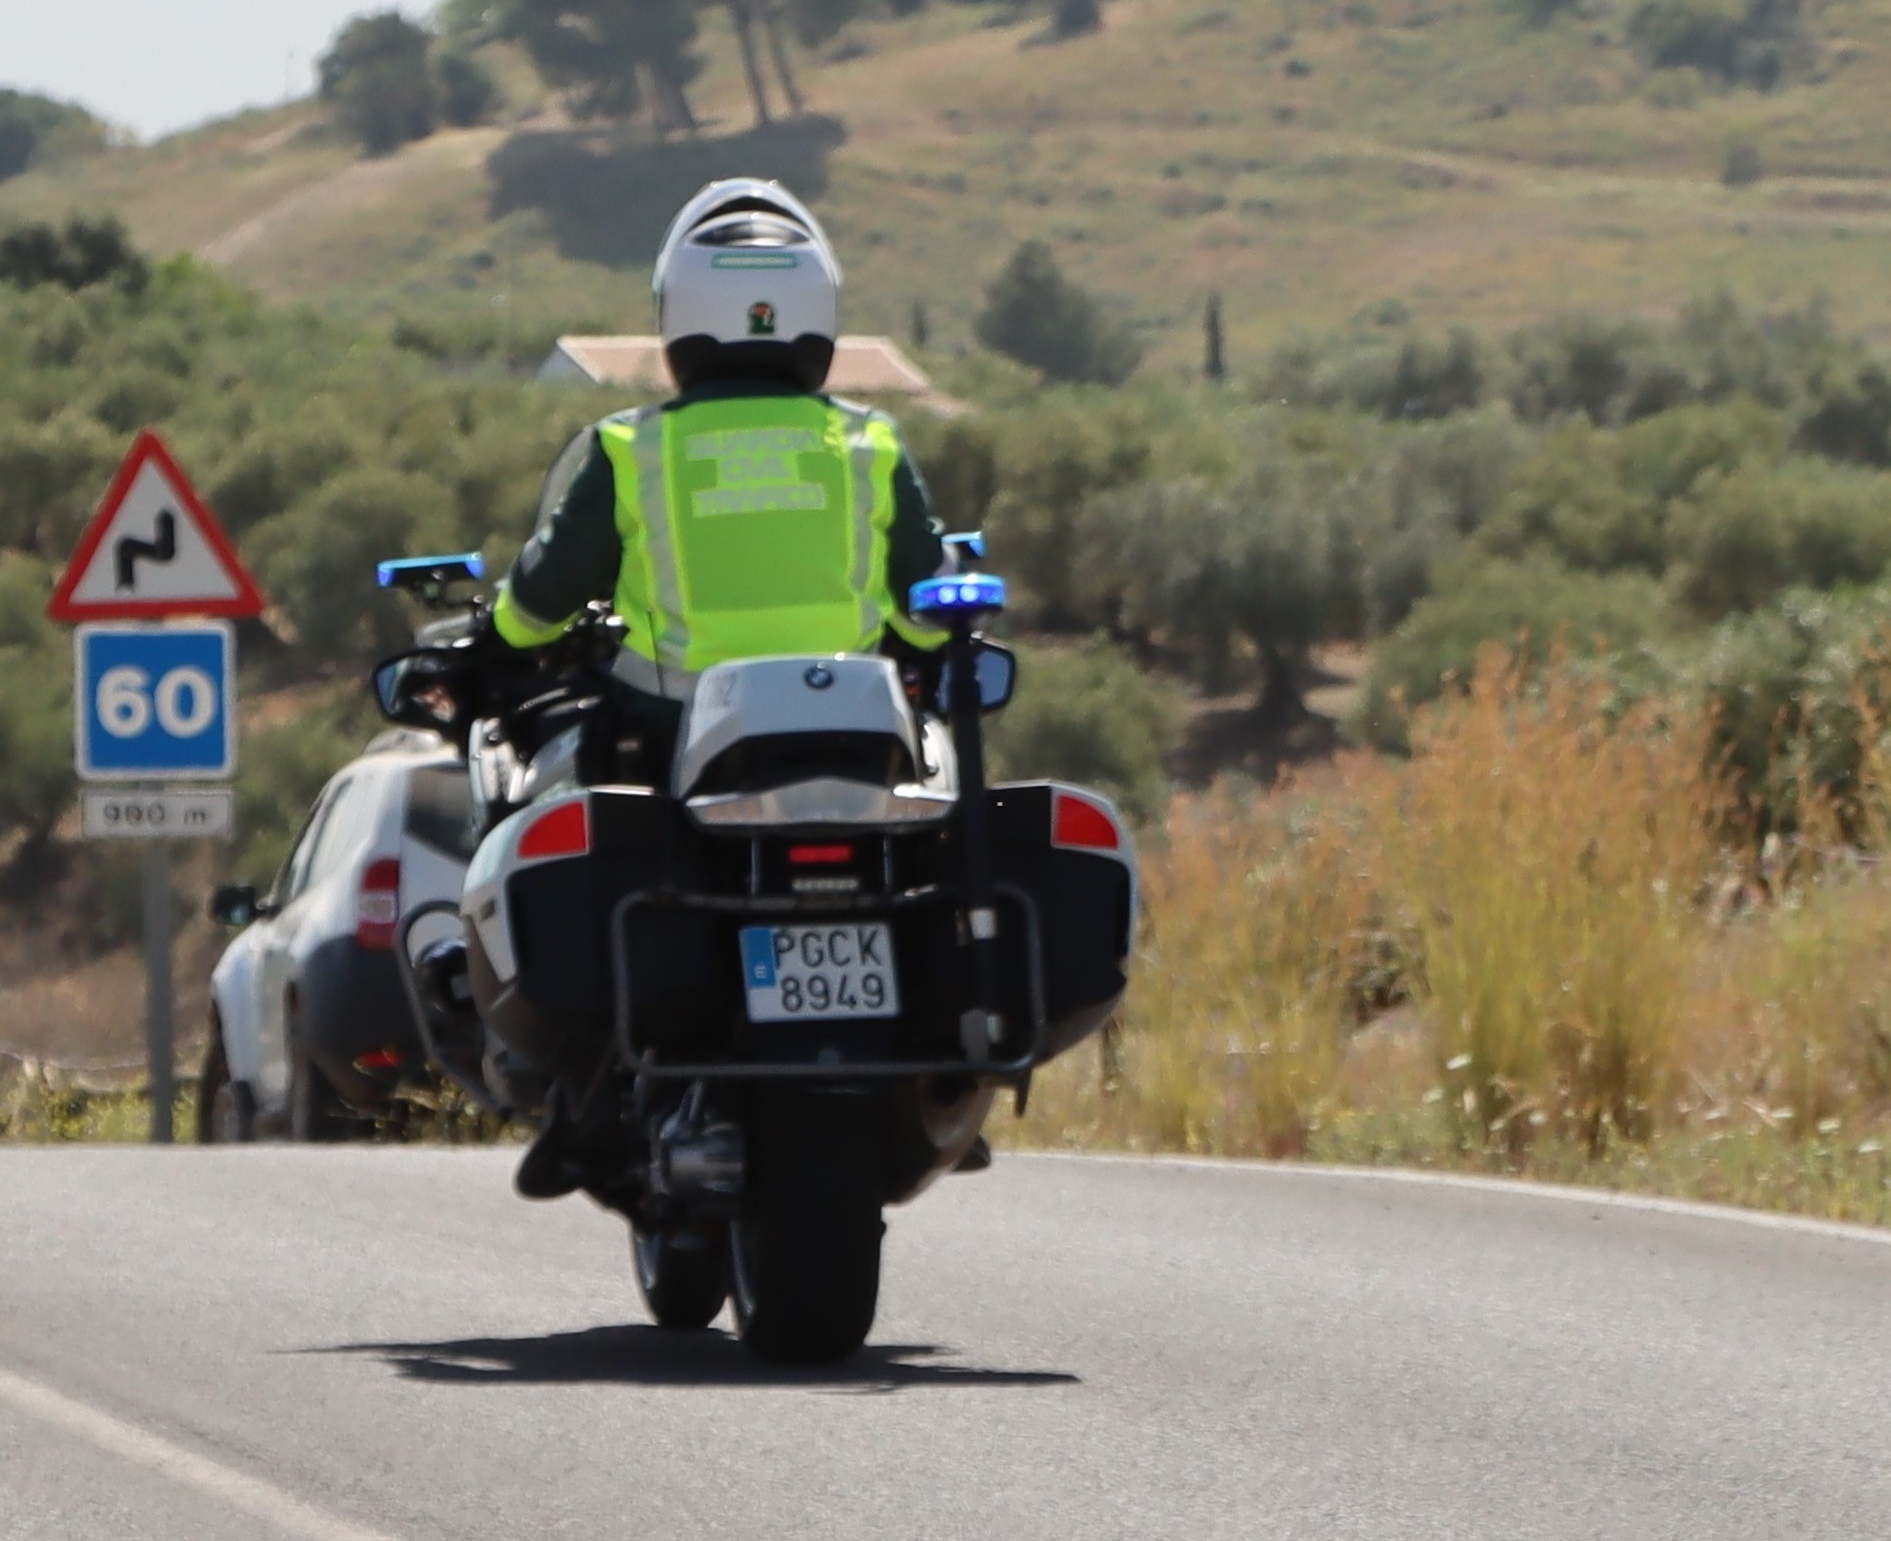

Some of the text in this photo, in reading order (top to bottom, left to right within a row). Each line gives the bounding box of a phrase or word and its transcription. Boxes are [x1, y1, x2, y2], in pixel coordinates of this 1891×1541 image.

[96, 665, 216, 738] 60
[184, 809, 206, 825] m
[773, 928, 881, 969] PGCK
[781, 973, 884, 1012] 8949
